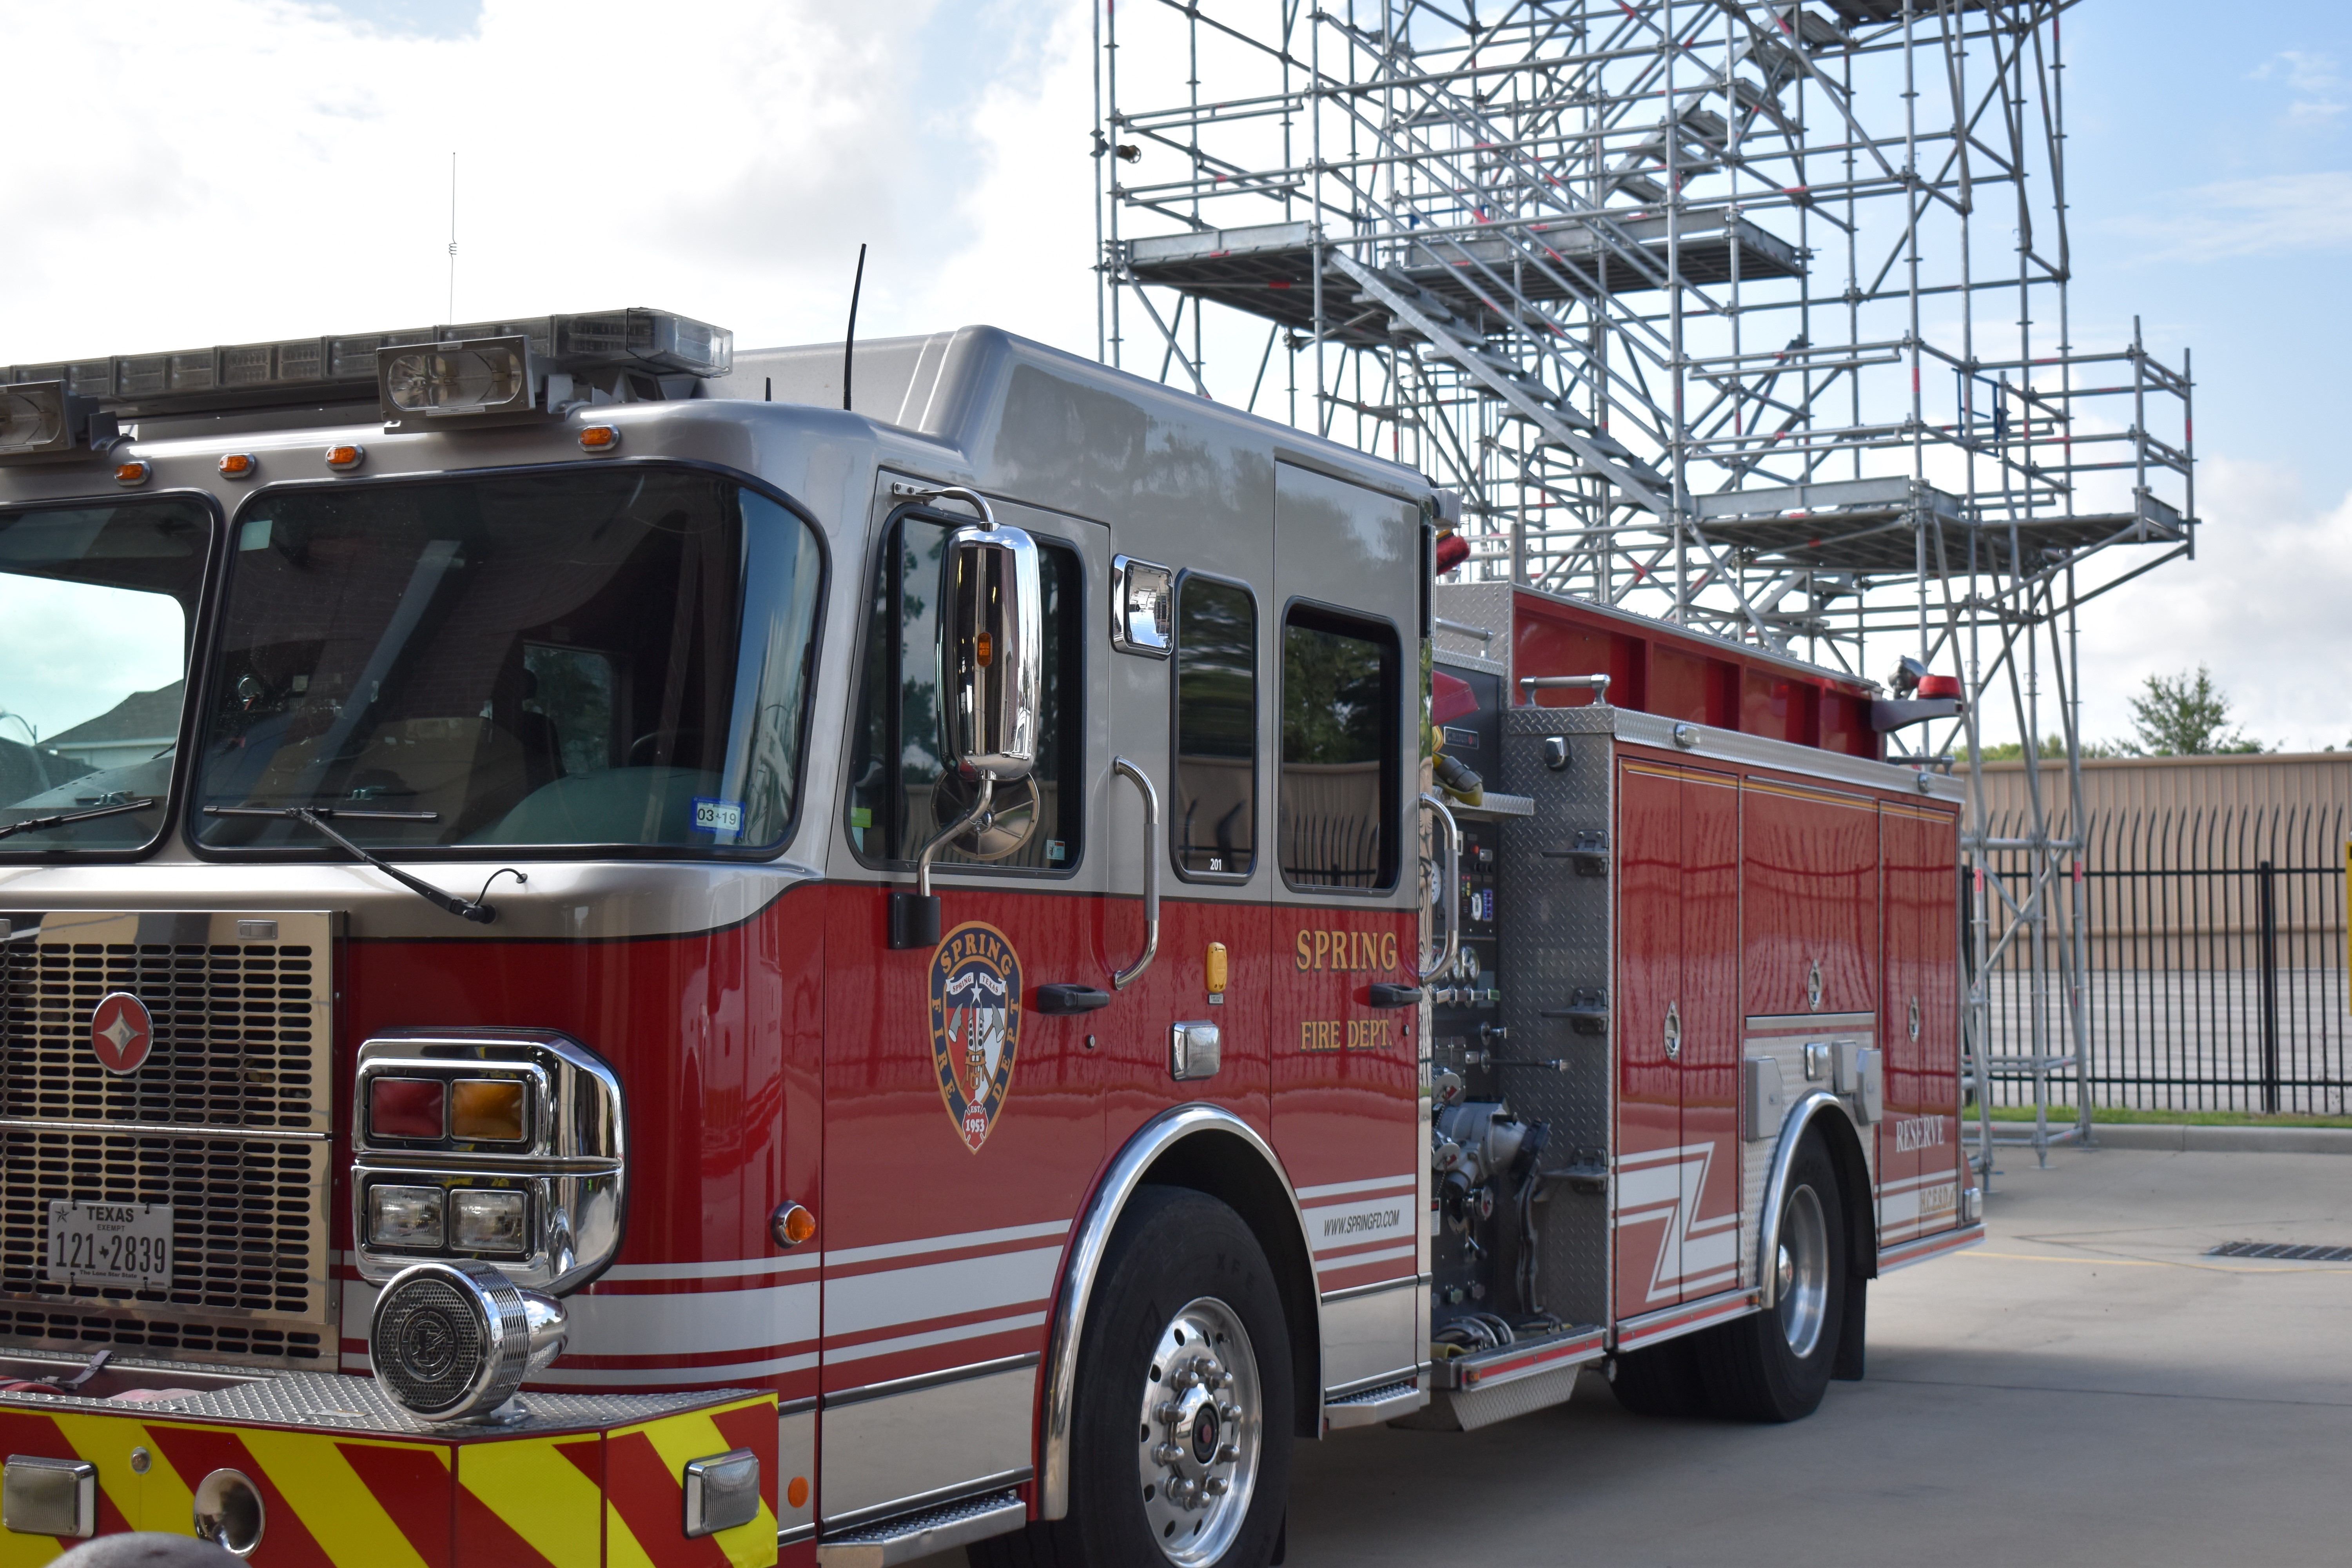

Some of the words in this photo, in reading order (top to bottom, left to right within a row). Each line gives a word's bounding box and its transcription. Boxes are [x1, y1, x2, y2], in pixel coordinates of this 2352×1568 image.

[697, 808, 714, 822] 03
[722, 812, 737, 825] 19
[1210, 858, 1221, 871] 201
[941, 933, 1013, 975] SPRING
[1296, 929, 1396, 972] SPRING
[953, 975, 971, 992] SPRING
[982, 976, 998, 993] TEXAS
[931, 997, 955, 1099] FIRE
[992, 998, 1019, 1103] DEPT
[1300, 1021, 1340, 1051] FIRE
[1347, 1019, 1393, 1050] DEPT.
[965, 1118, 985, 1132] 1953
[1896, 1114, 1945, 1153] RESERVE
[86, 1206, 134, 1223] TEXAS
[1324, 1209, 1399, 1236] WWW.SPRINGFD.COM
[56, 1232, 96, 1269] 121
[110, 1235, 165, 1273] 2839
